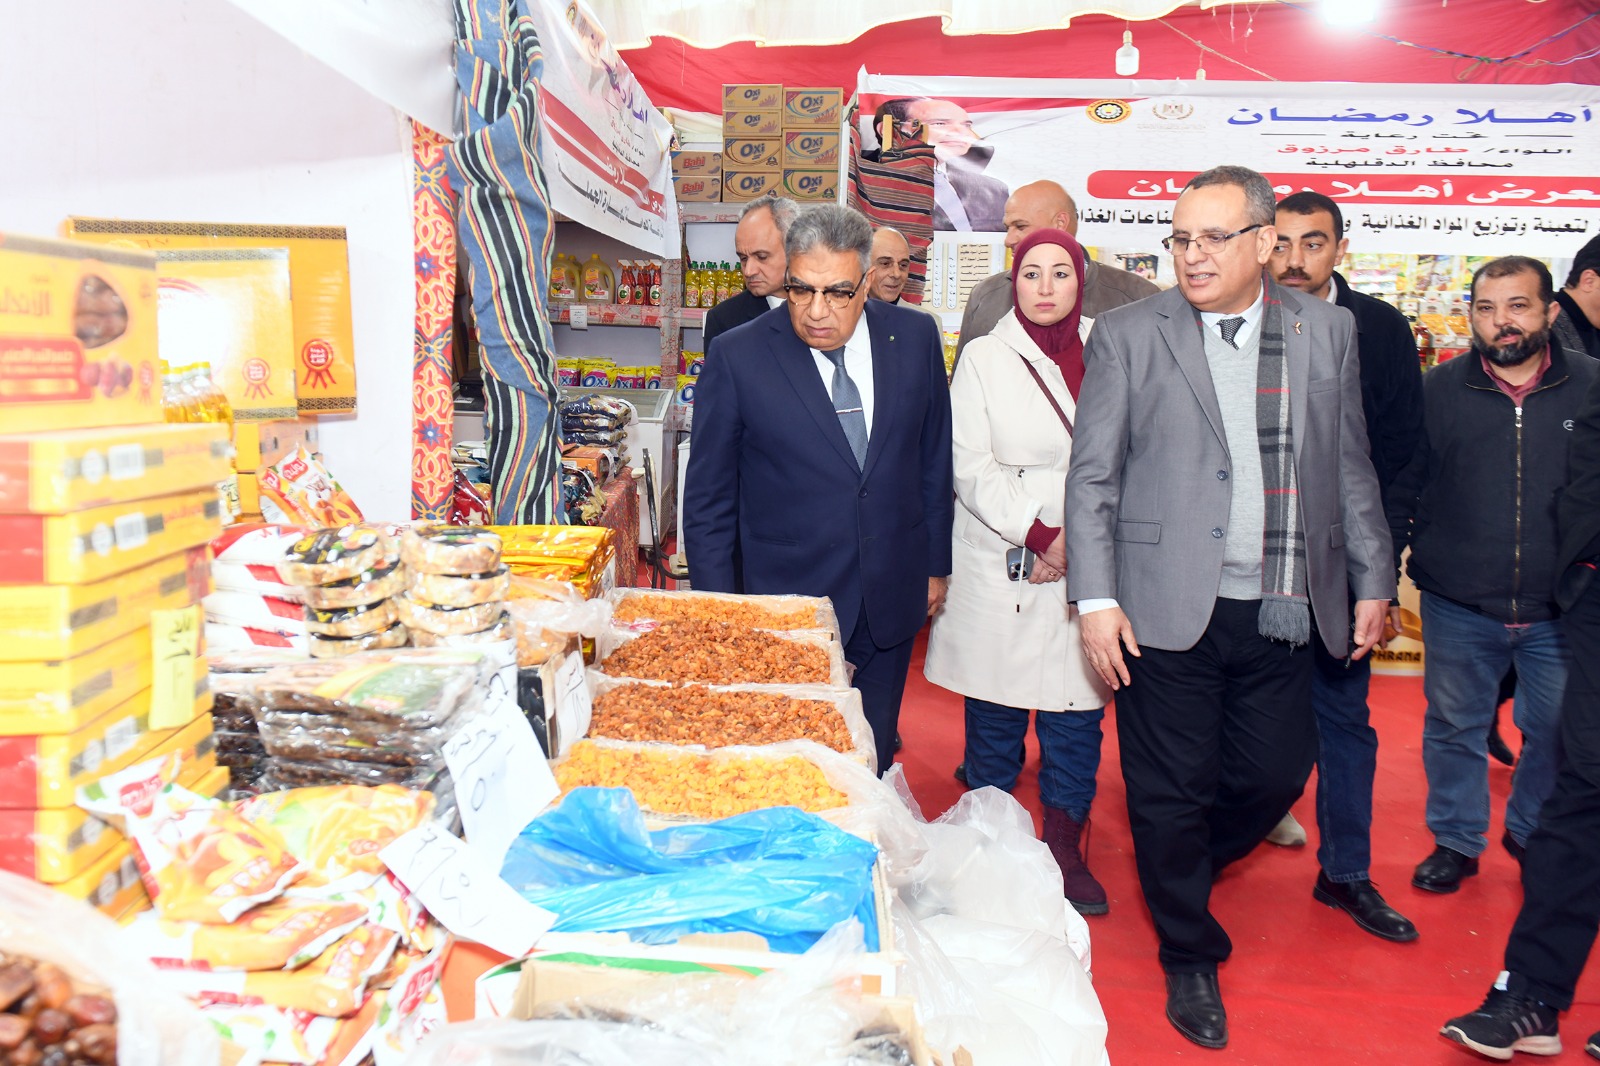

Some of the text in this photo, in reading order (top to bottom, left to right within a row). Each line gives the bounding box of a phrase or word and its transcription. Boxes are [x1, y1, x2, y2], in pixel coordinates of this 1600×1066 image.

[744, 89, 761, 99] Oxi
[800, 96, 824, 109] Oxi
[744, 114, 761, 125] Oxi
[1227, 105, 1592, 127] أهلا رمضان
[1341, 130, 1418, 140] رعاية
[740, 143, 766, 158] Oxi
[800, 137, 824, 151] Oxi
[1277, 144, 1371, 154] مرزوق
[1385, 145, 1469, 155] طارق
[1427, 158, 1513, 168] محافظ
[740, 175, 766, 190] Oxi
[798, 175, 823, 190] Oxi
[1327, 178, 1454, 199] أهلا
[1466, 182, 1600, 204] عرض
[1361, 213, 1428, 233] الغذائية
[1432, 216, 1467, 235] المواد
[1473, 215, 1527, 237] وتوزيع
